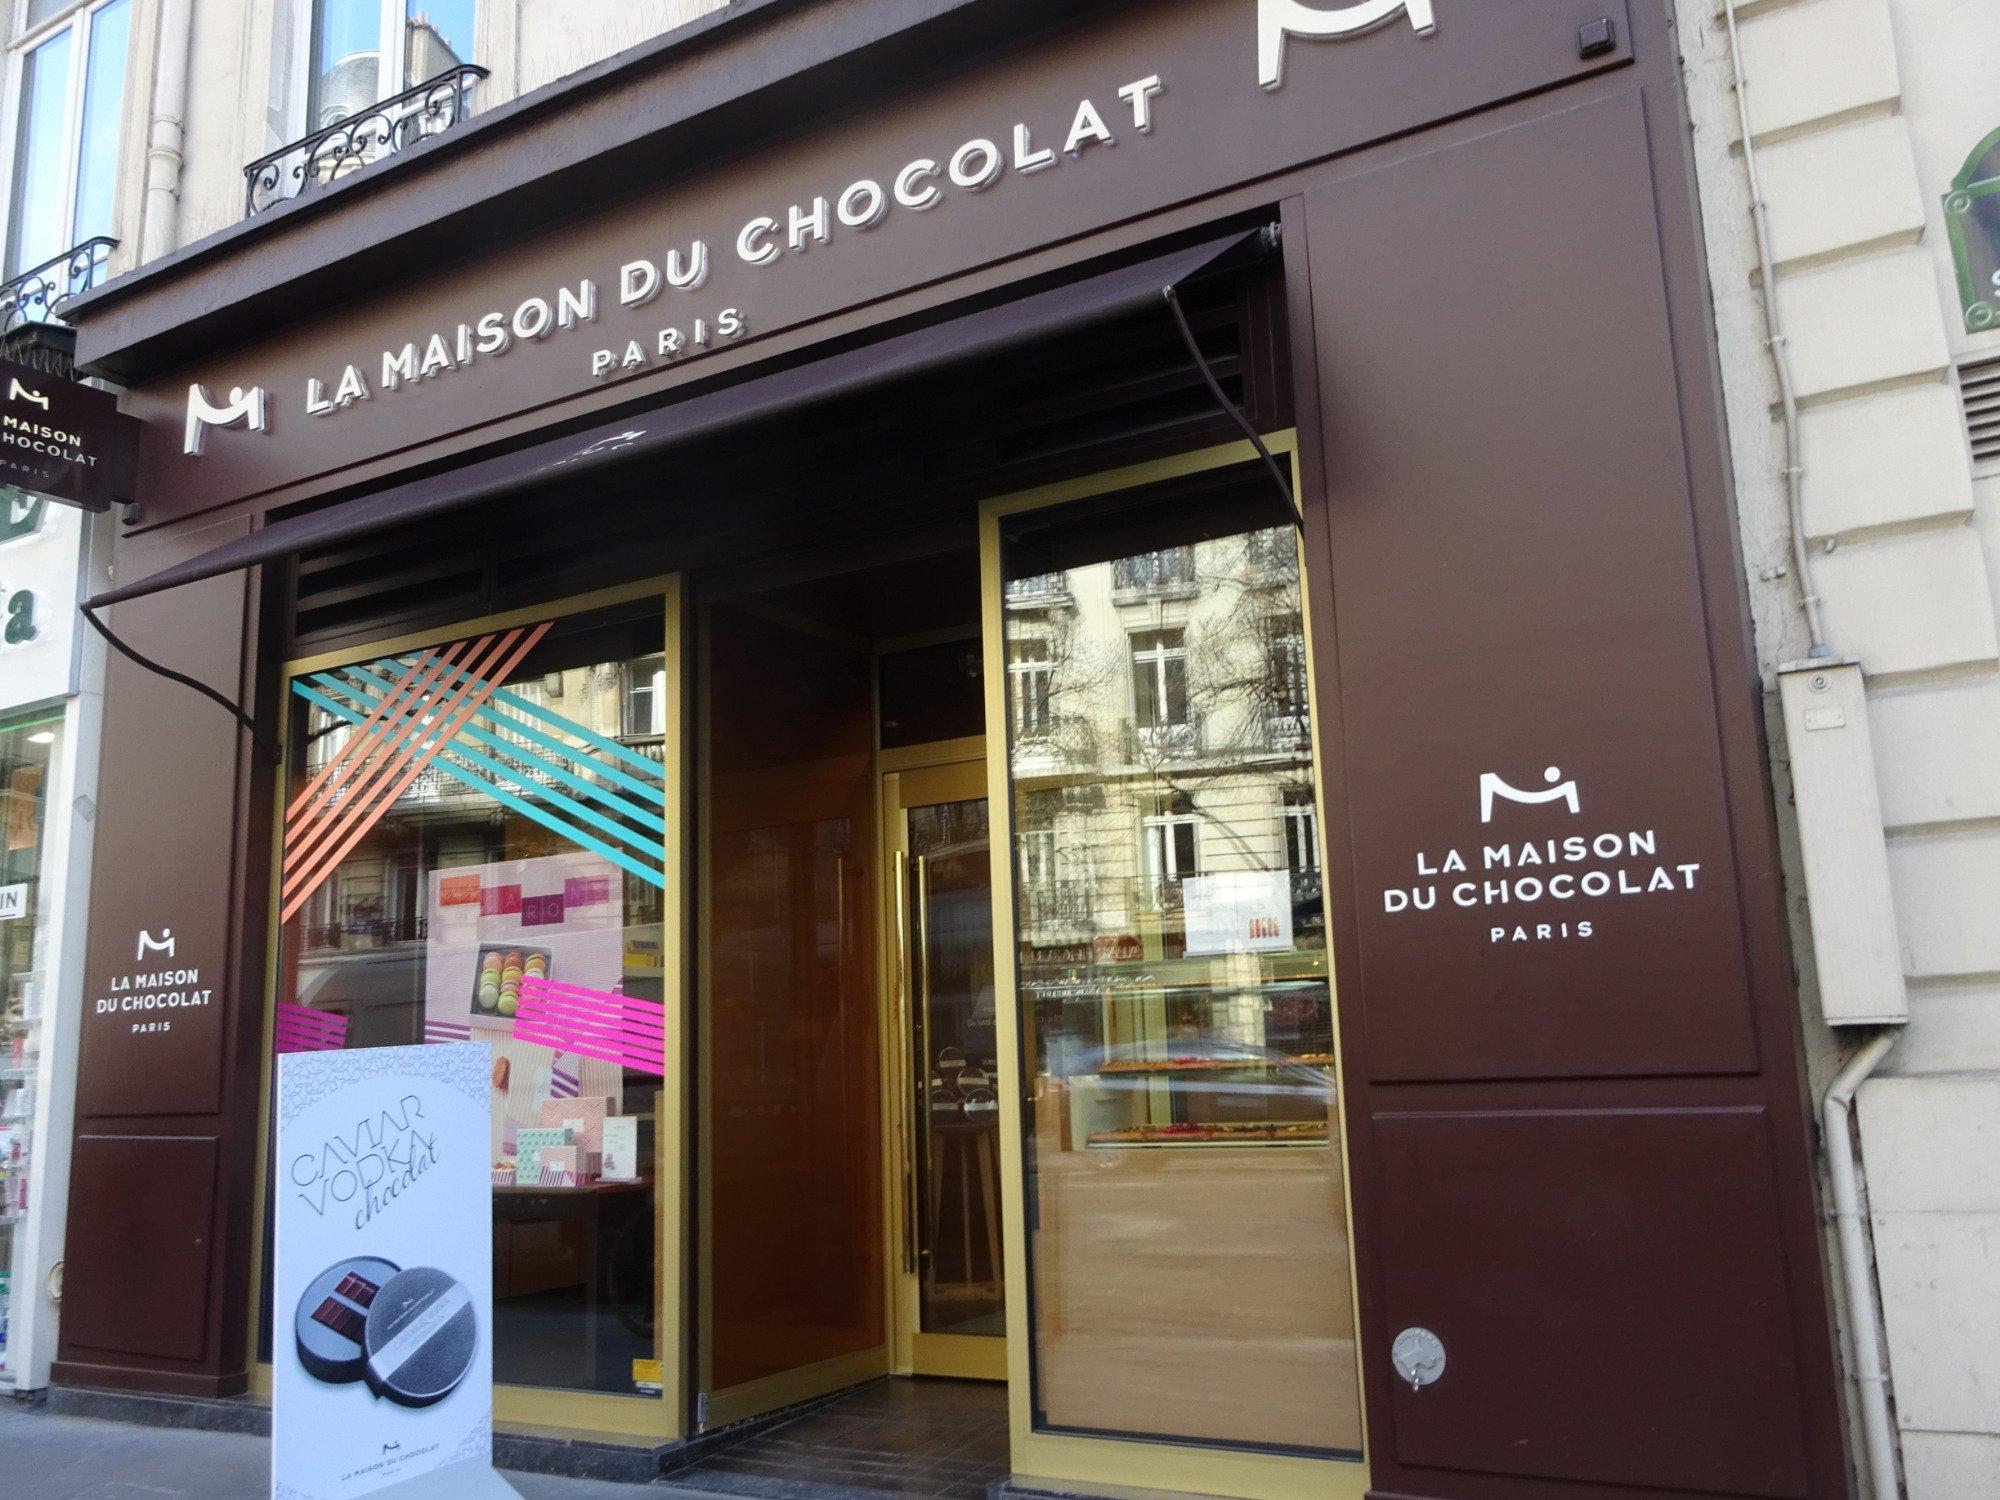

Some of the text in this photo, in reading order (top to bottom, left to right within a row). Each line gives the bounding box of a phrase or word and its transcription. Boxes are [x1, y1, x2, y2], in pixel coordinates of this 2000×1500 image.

[307, 74, 1163, 416] LA MAISON DU CHOCOLAT
[591, 308, 746, 377] PARIS
[3, 415, 81, 447] MAISON
[1417, 830, 1655, 875] LA MAISON
[1384, 863, 1700, 913] DU CHOCOLAT
[1491, 921, 1593, 943] PARIS
[97, 990, 211, 1013] DU CHOCOLAT
[111, 969, 198, 991] LA MAISON
[132, 1022, 171, 1033] PARIS
[291, 1095, 425, 1186] CAVIAR
[298, 1130, 433, 1216] VODKA
[355, 1132, 438, 1229] chocolat
